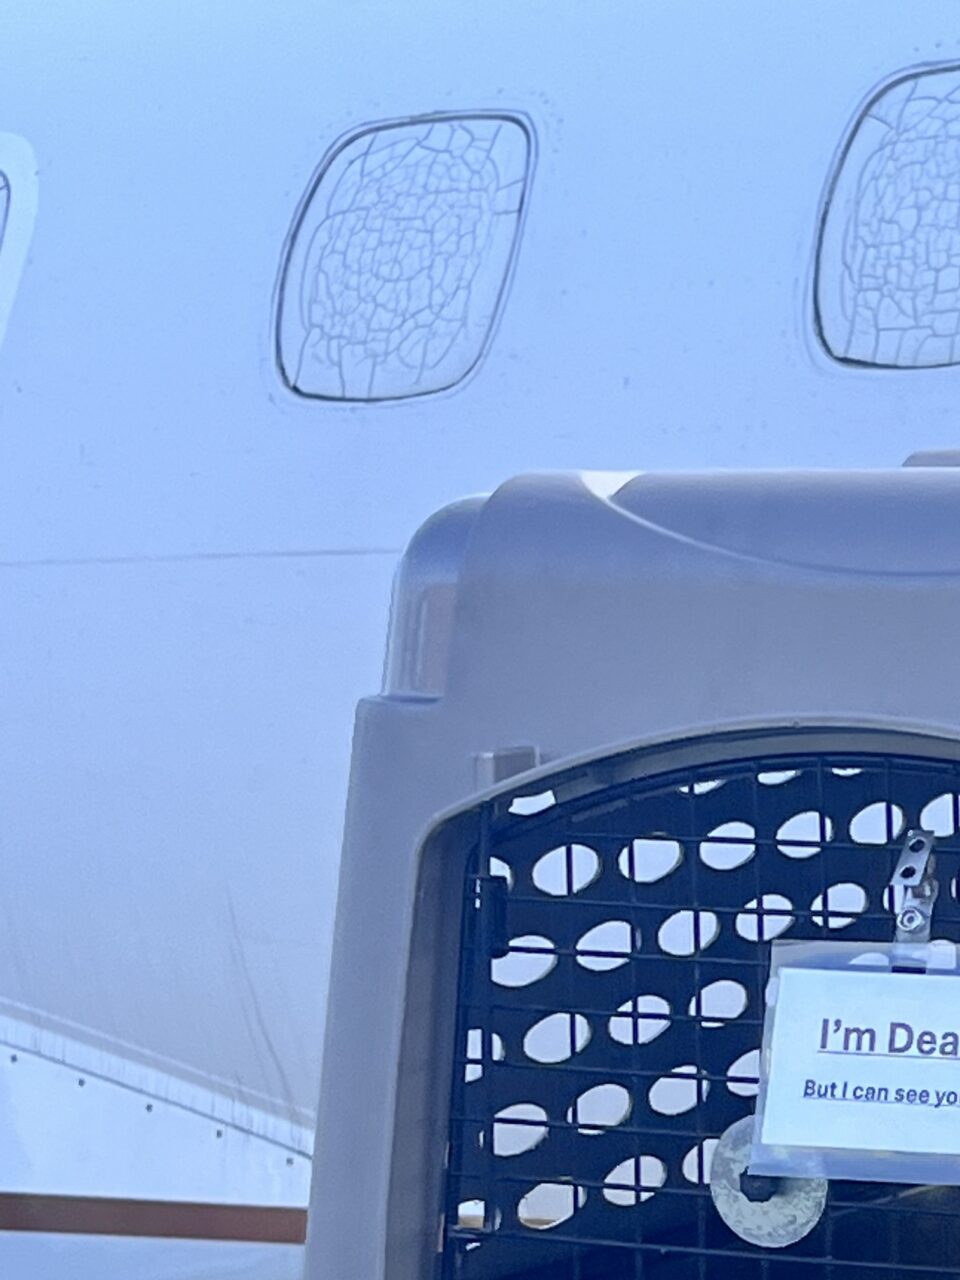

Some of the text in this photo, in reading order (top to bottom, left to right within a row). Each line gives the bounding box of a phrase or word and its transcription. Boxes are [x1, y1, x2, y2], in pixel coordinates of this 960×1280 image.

[803, 1079, 838, 1099] But
[841, 1081, 849, 1099] I
[852, 1085, 890, 1102] can
[893, 1087, 931, 1104] see
